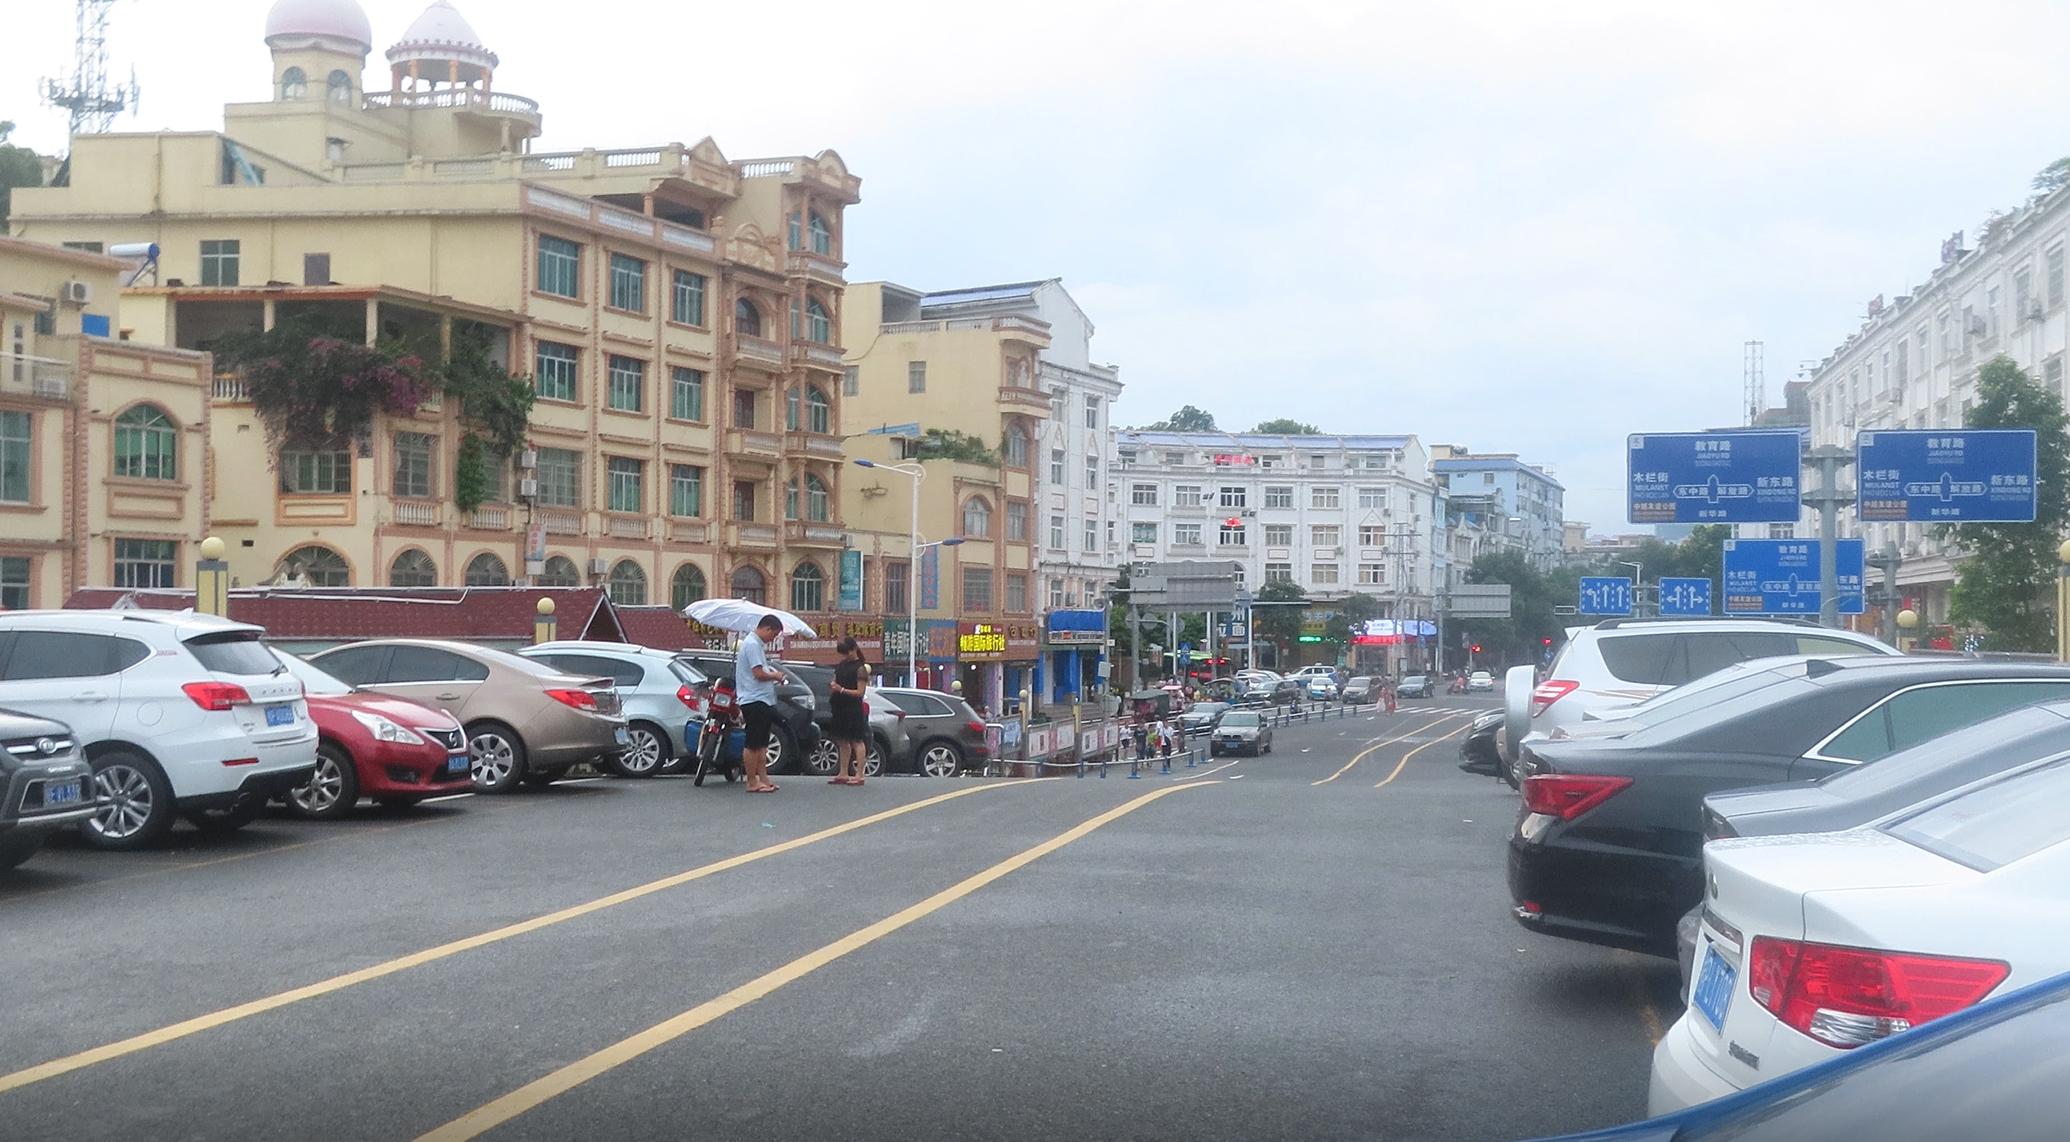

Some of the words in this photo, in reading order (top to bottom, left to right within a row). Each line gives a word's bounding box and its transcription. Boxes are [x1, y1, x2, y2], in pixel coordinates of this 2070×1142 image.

[1695, 440, 1730, 451] 教育路
[1927, 438, 1964, 448] 教育路
[1633, 472, 1668, 483] 木栏街
[1864, 470, 1900, 480] 木栏街
[1992, 474, 2028, 486] 新东路
[1757, 476, 1793, 488] 新东路
[1679, 487, 1708, 496] 东中路
[1717, 487, 1748, 496] 解放路
[1910, 485, 1941, 494] 东中路
[1950, 484, 1982, 494] 解放路
[1699, 510, 1727, 518] 新华路
[1931, 508, 1960, 516] 新华路
[1728, 571, 1756, 580] 木栏街
[884, 631, 928, 655] 青年国际行社
